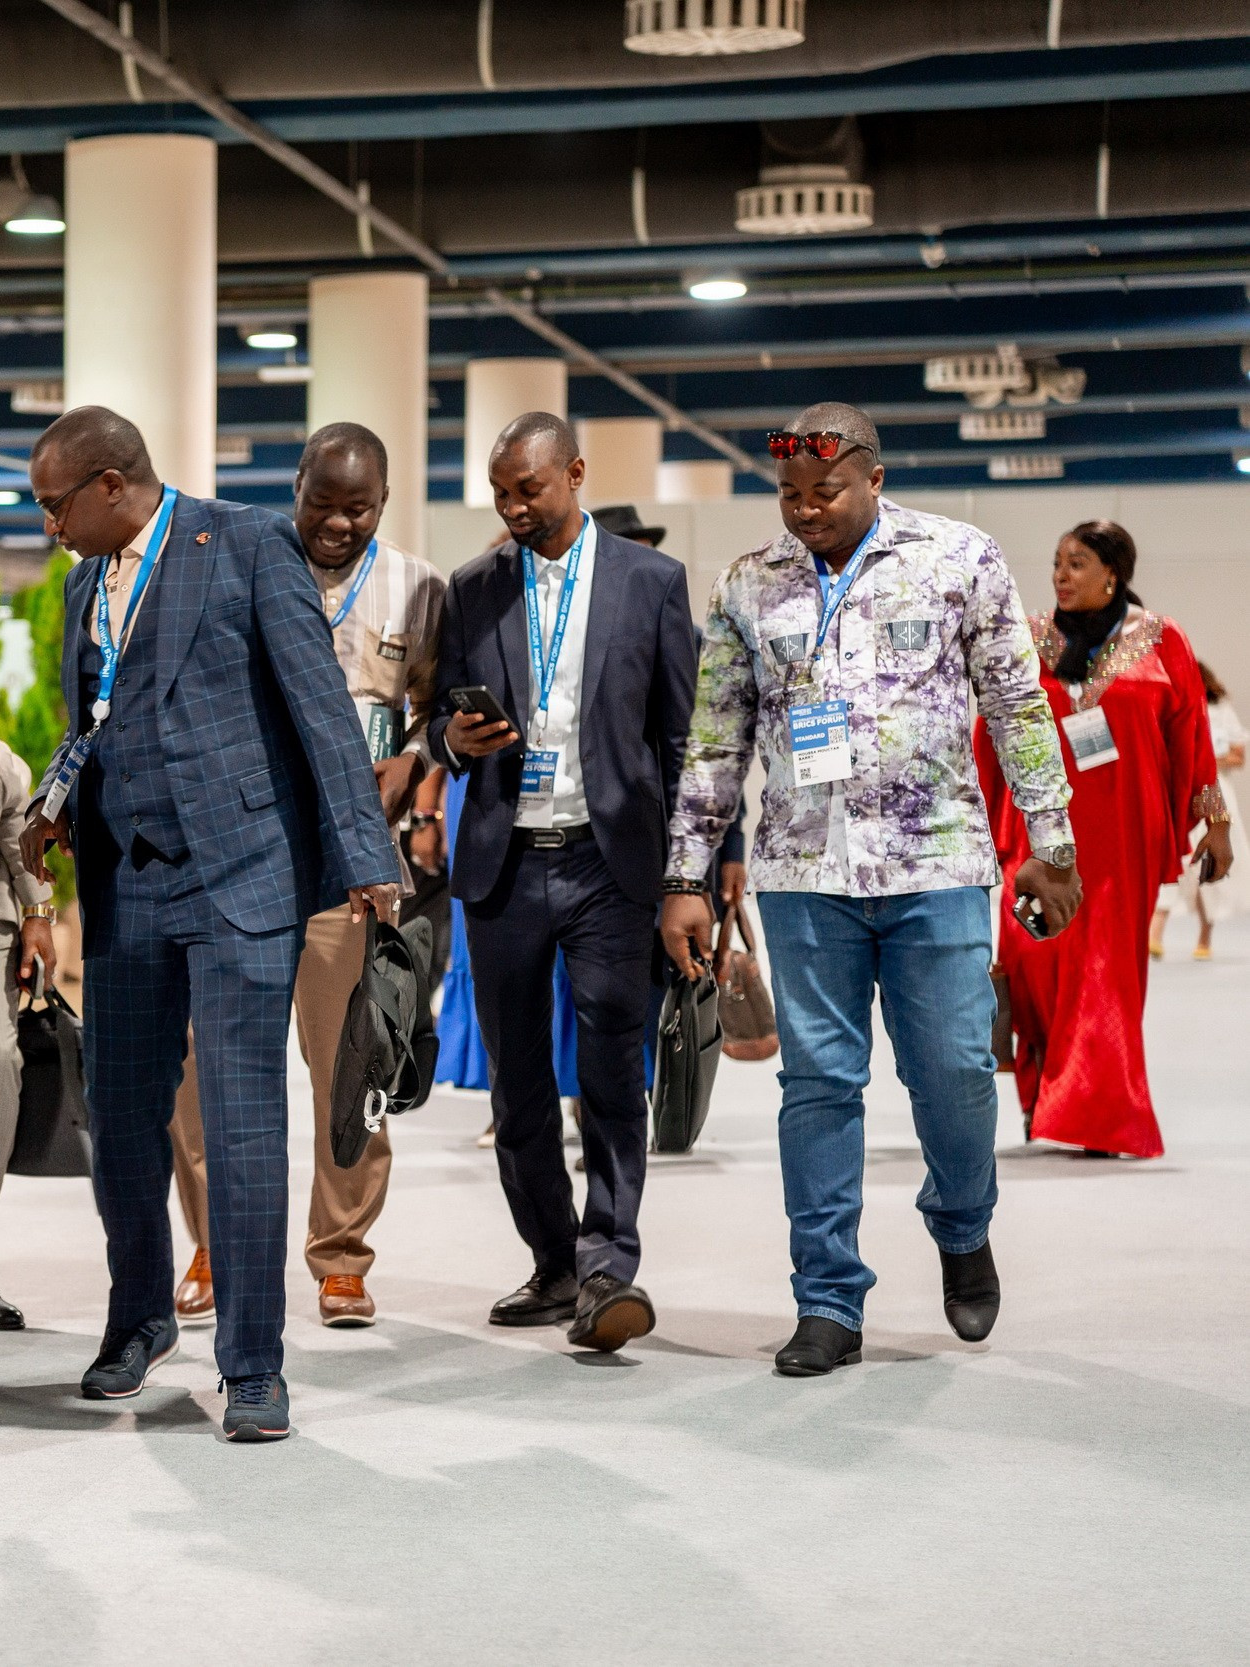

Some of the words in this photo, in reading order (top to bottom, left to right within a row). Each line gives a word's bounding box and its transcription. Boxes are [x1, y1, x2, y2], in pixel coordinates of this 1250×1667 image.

[567, 550, 579, 580] IMBRICS
[530, 619, 540, 646] FORUM
[551, 634, 561, 662] FORUM
[793, 719, 816, 730] BRICS
[817, 713, 845, 726] FORUM
[794, 732, 826, 743] STANDARD
[533, 764, 555, 772] FORUM
